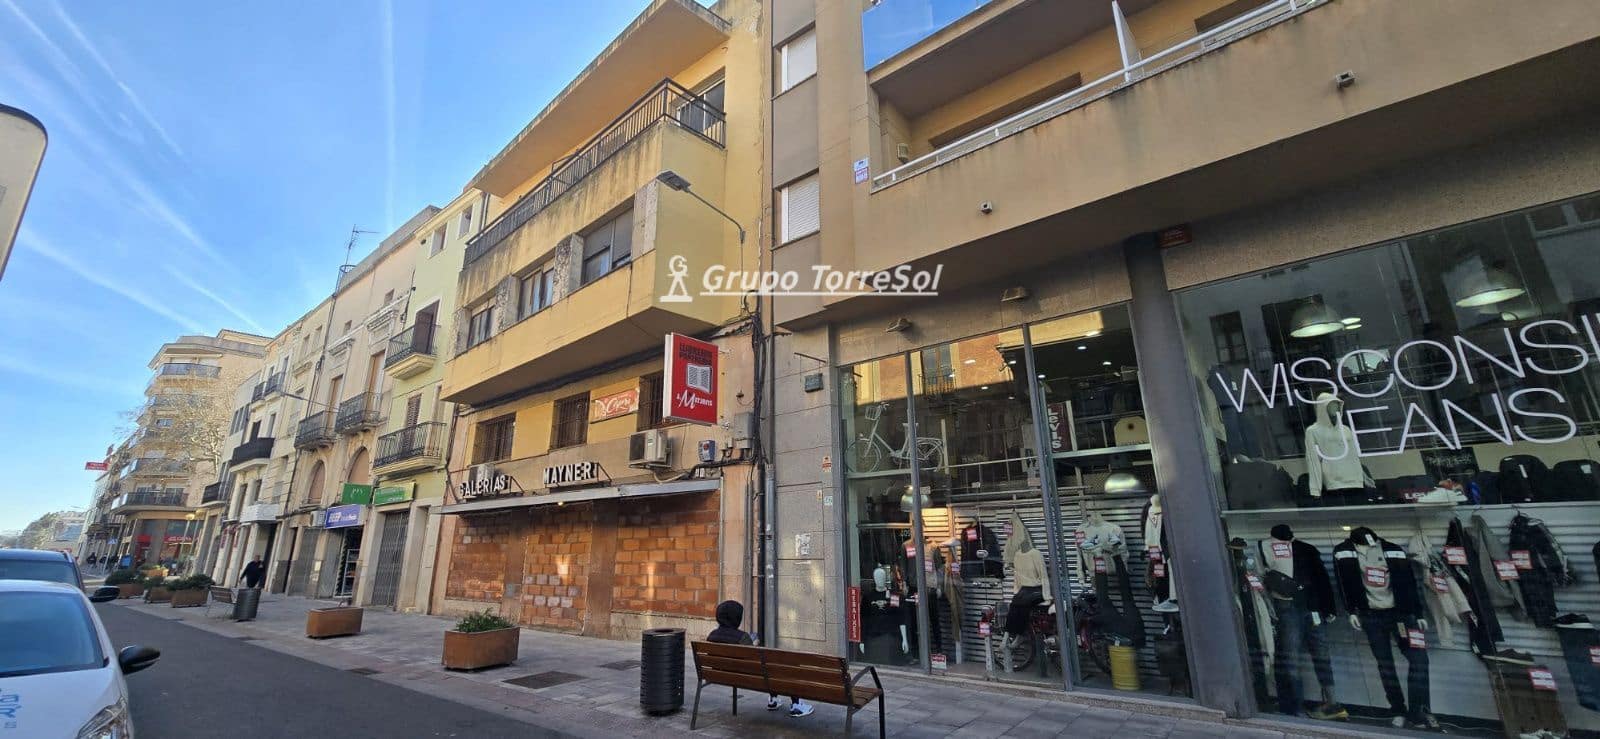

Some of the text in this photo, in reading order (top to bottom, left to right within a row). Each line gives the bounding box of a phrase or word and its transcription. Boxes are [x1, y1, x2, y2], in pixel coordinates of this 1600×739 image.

[1314, 387, 1578, 461] JEANS
[458, 461, 592, 497] GALERIAS MAYNER
